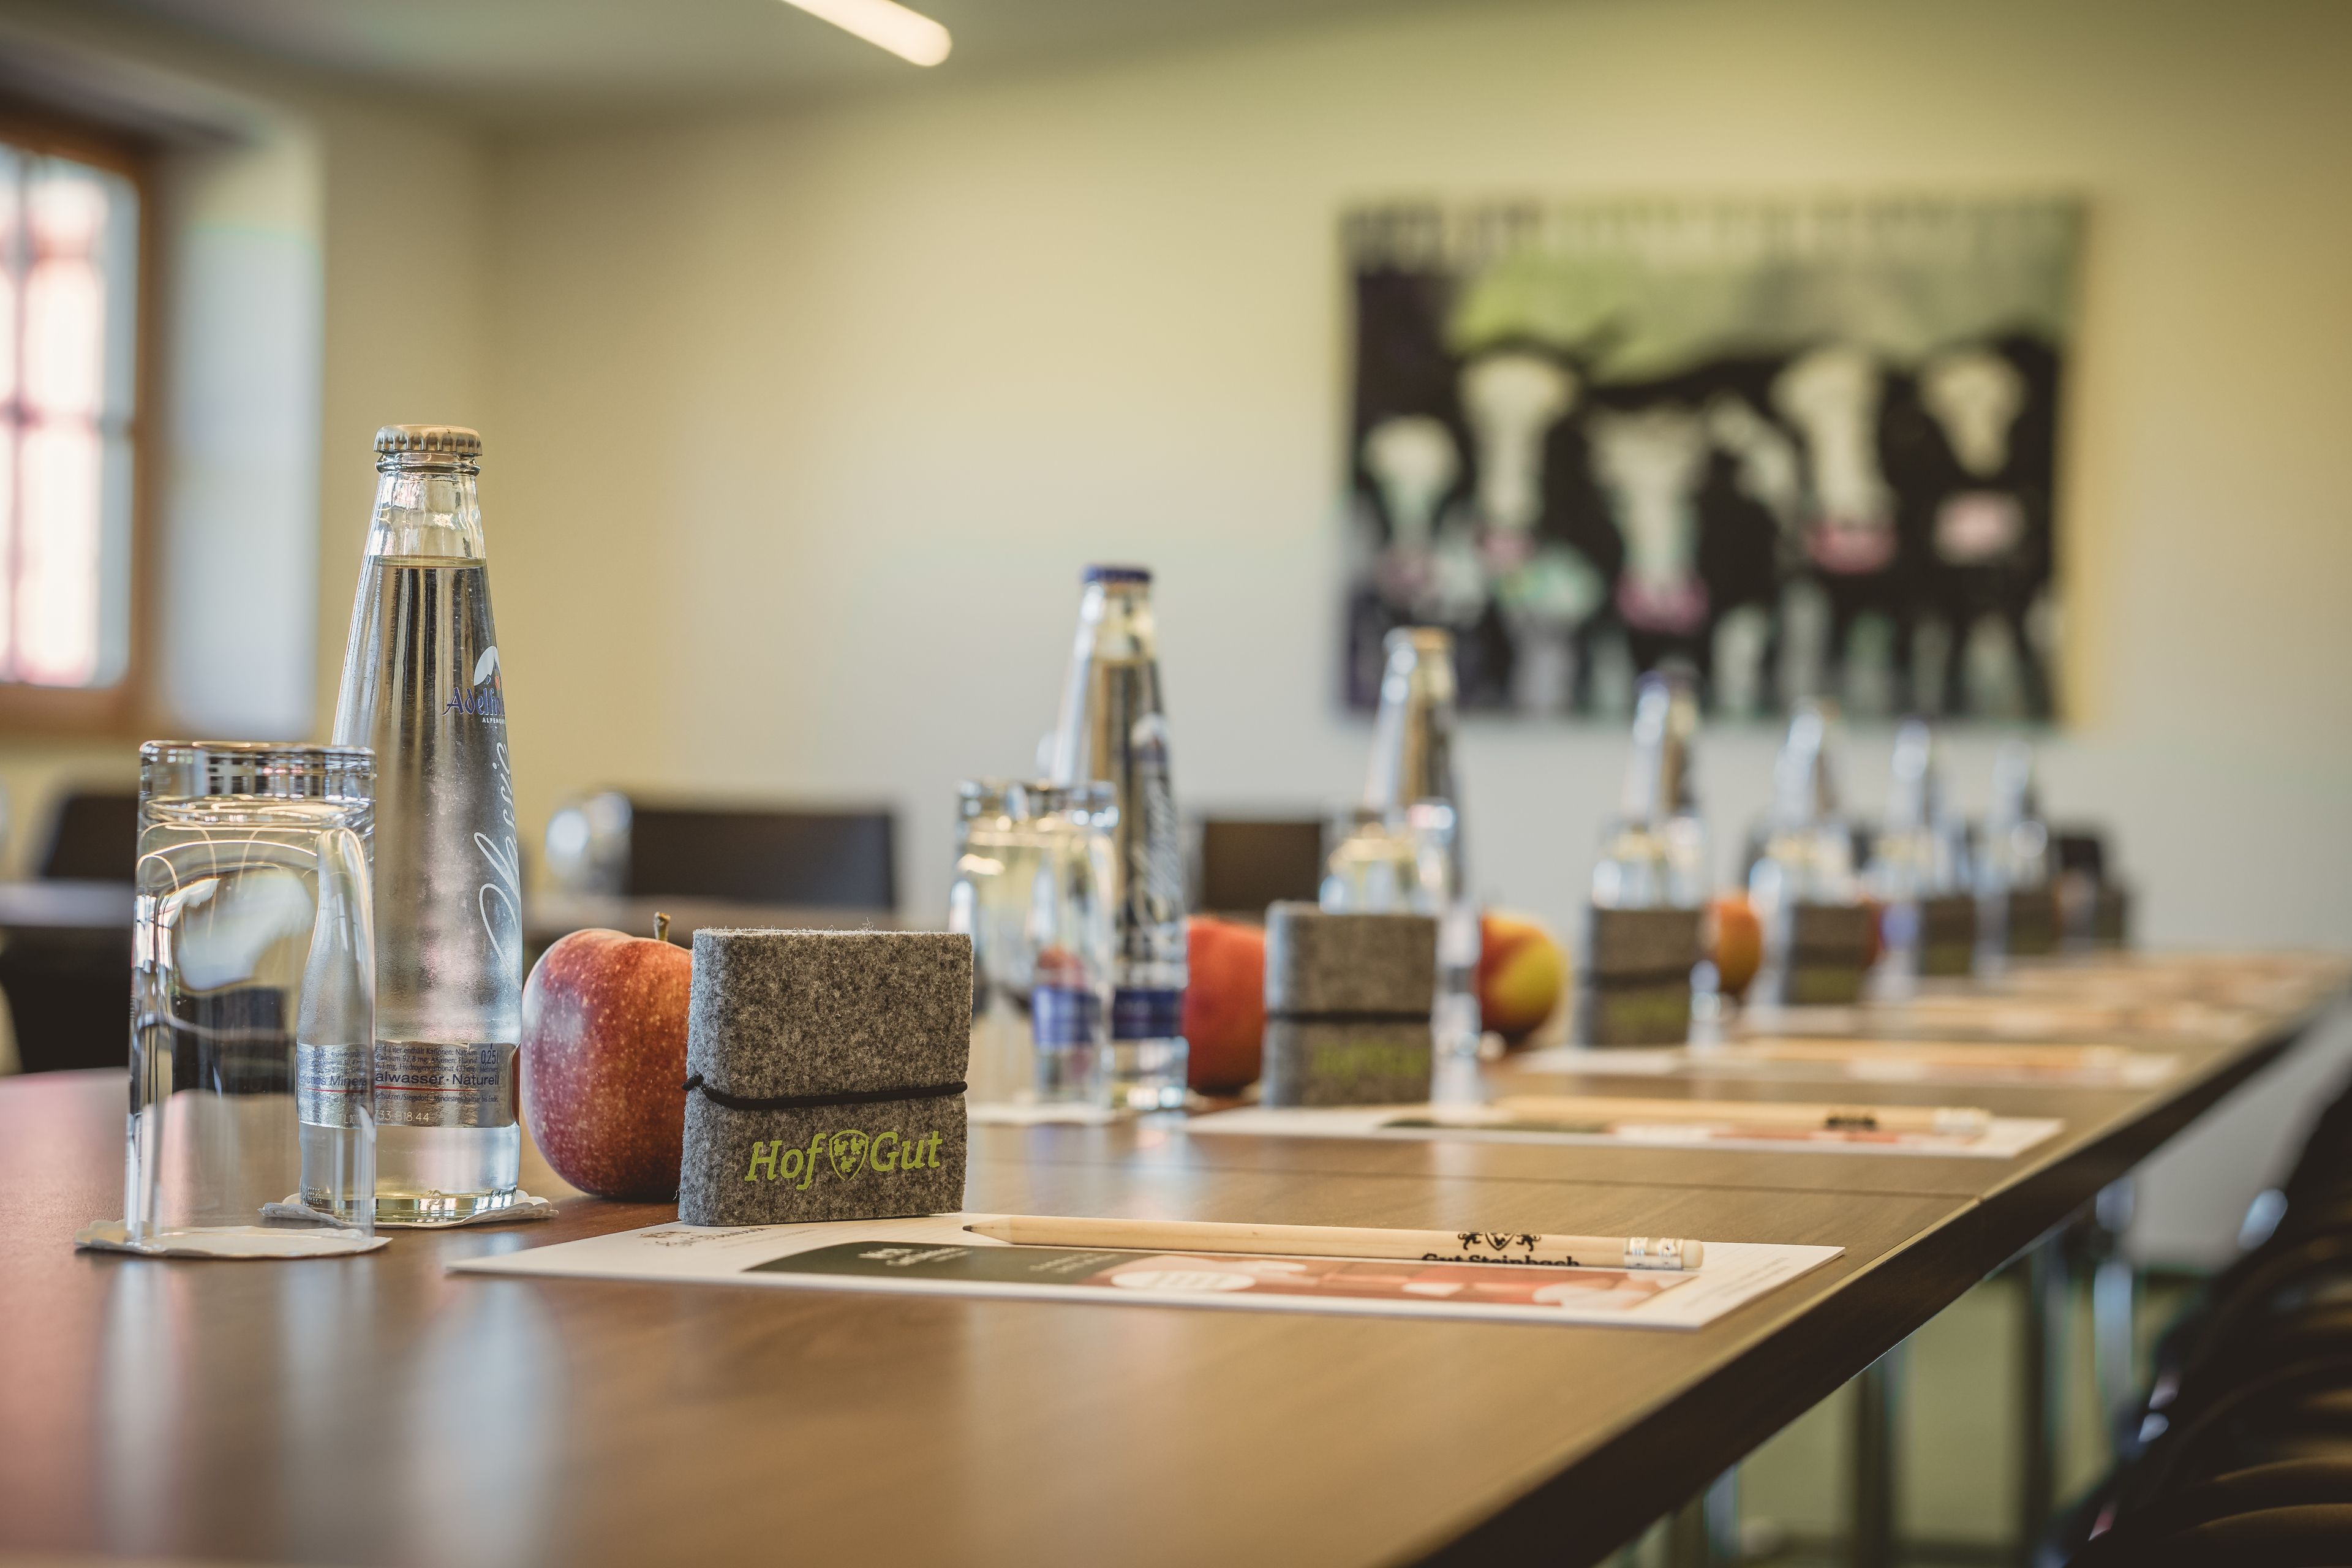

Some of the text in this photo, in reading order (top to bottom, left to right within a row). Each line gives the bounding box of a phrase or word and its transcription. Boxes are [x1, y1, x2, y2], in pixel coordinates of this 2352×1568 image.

[376, 1053, 401, 1062] Calcium
[402, 1055, 416, 1064] 92,8
[399, 1063, 454, 1072] Hydrogencarbonat
[452, 1074, 499, 1086] Naturell
[744, 1131, 943, 1190] Hof Gut
